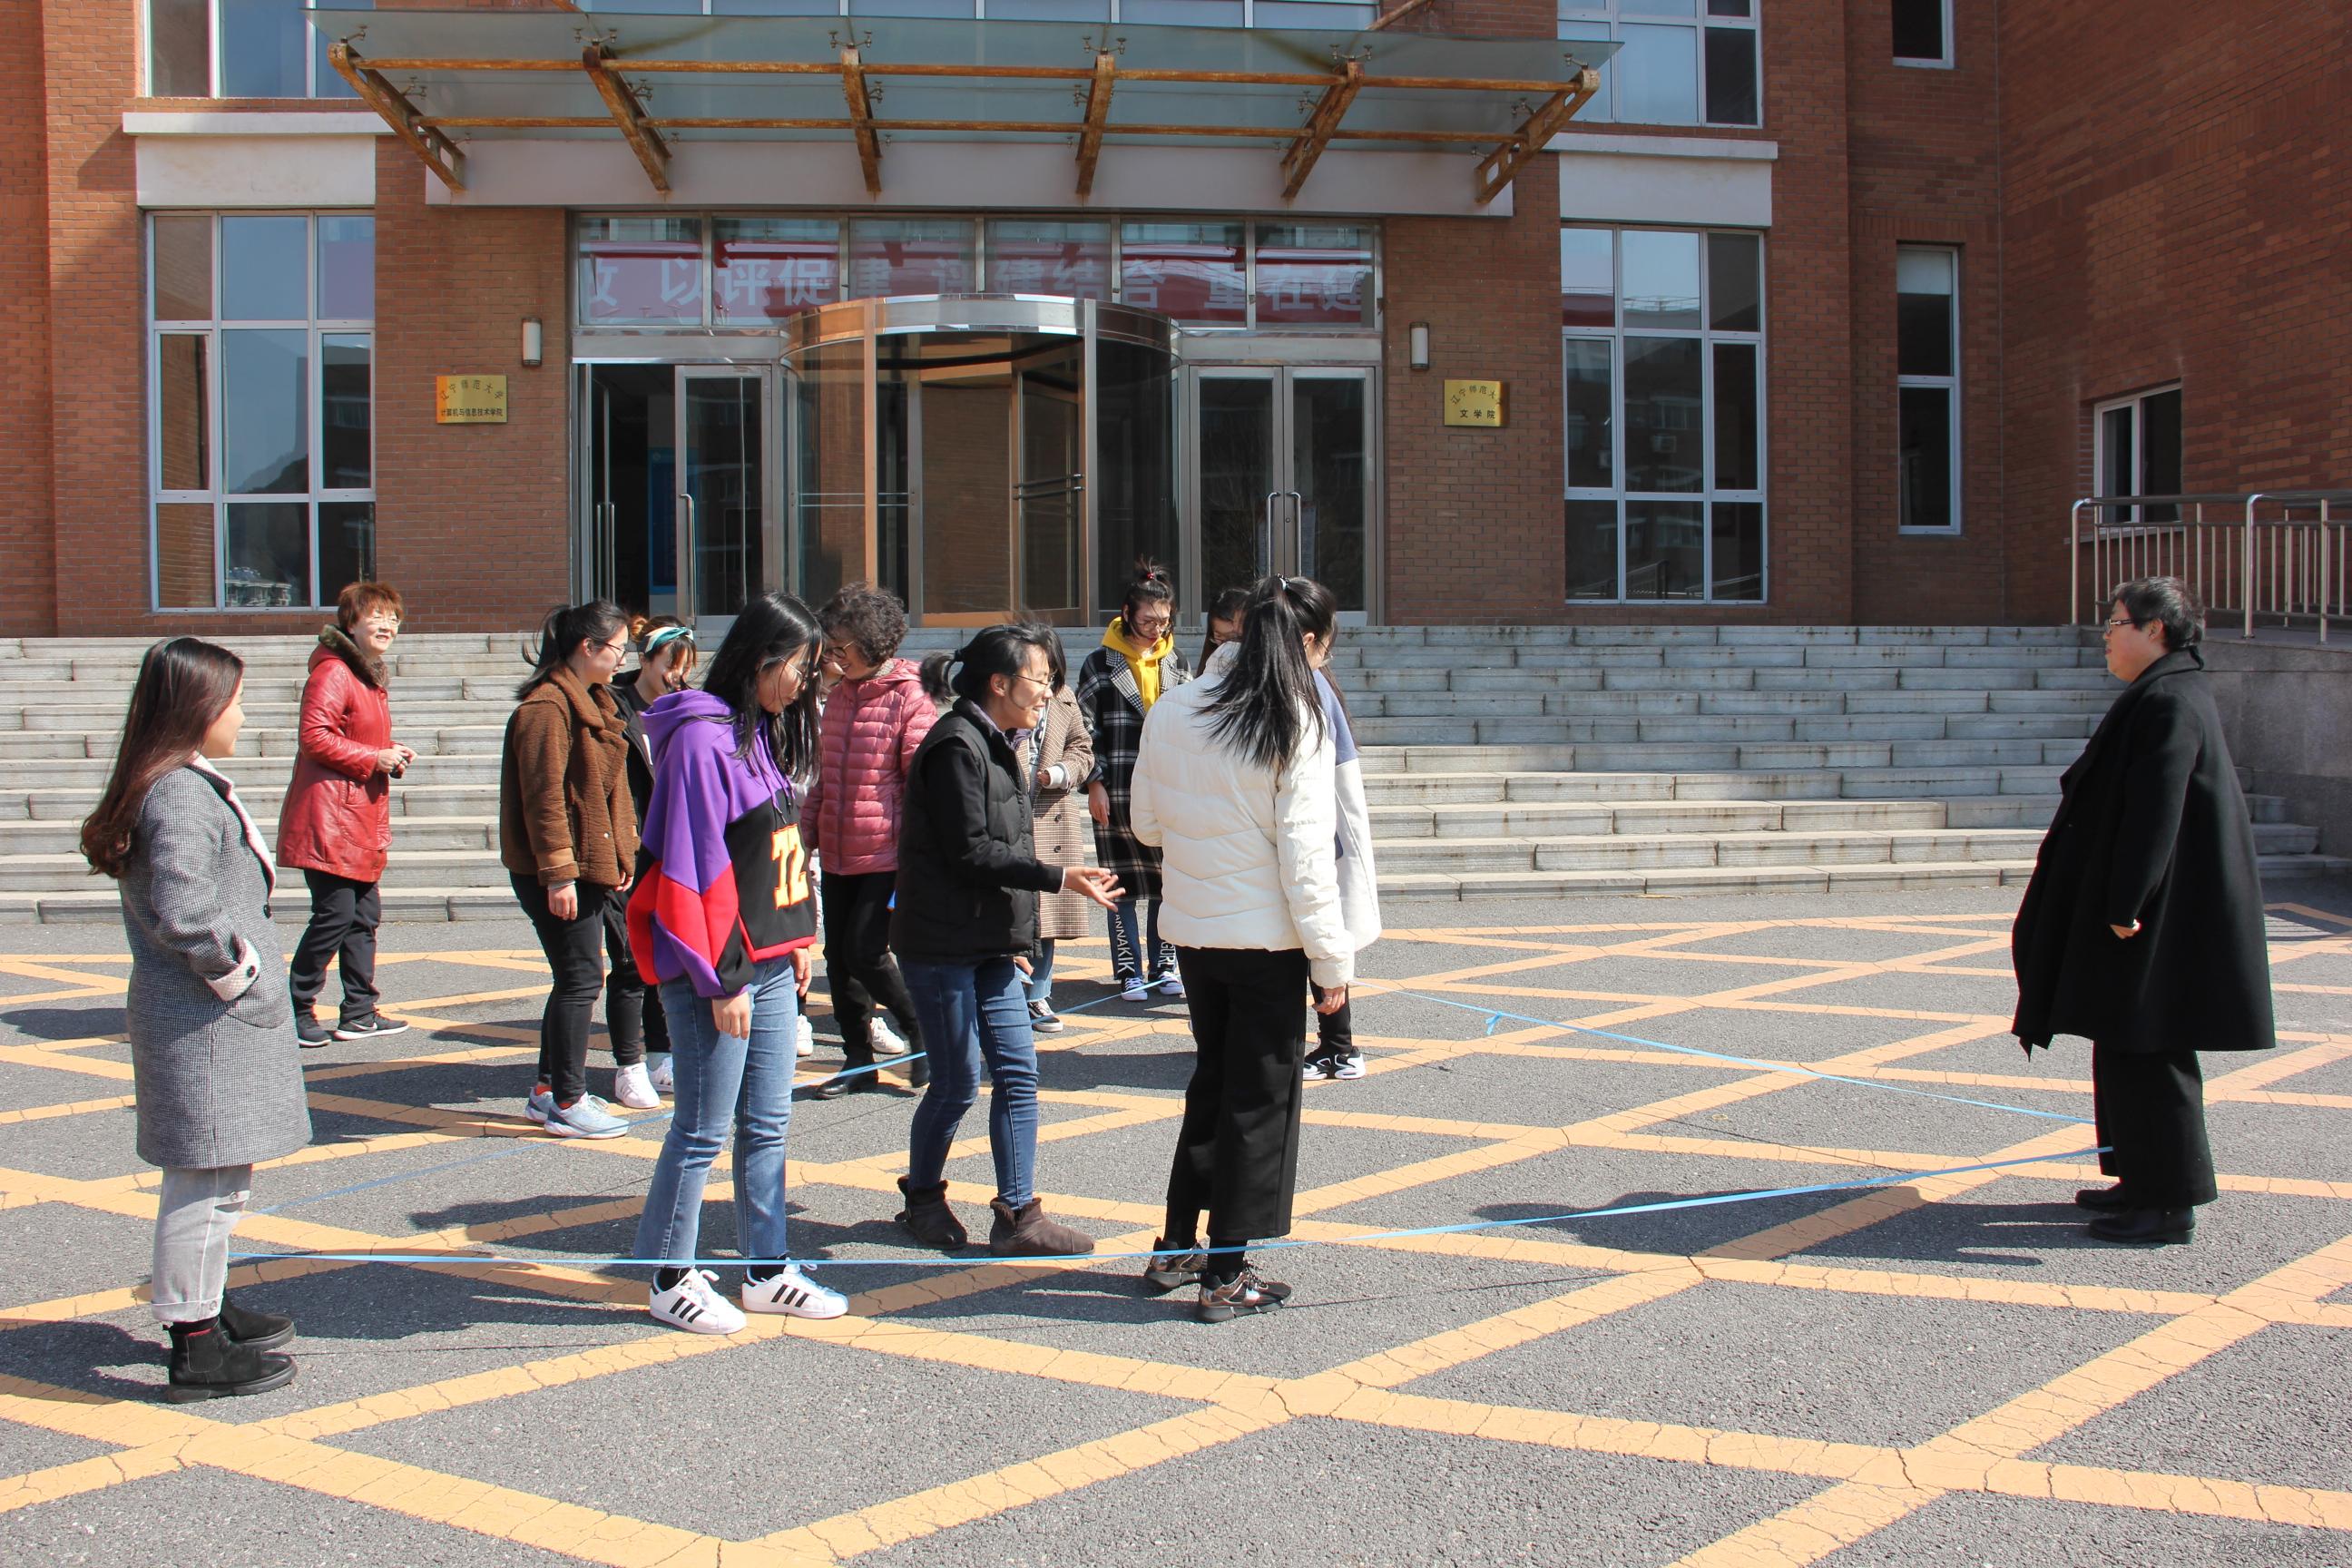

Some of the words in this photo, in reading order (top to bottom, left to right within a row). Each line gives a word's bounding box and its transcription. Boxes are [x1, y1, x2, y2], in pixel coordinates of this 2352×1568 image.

[439, 379, 504, 400] 辽宁师范大学
[1450, 385, 1501, 405] 辽宁师范大
[441, 407, 504, 417] 计算机与信息技术学院
[1459, 408, 1495, 419] 文学院
